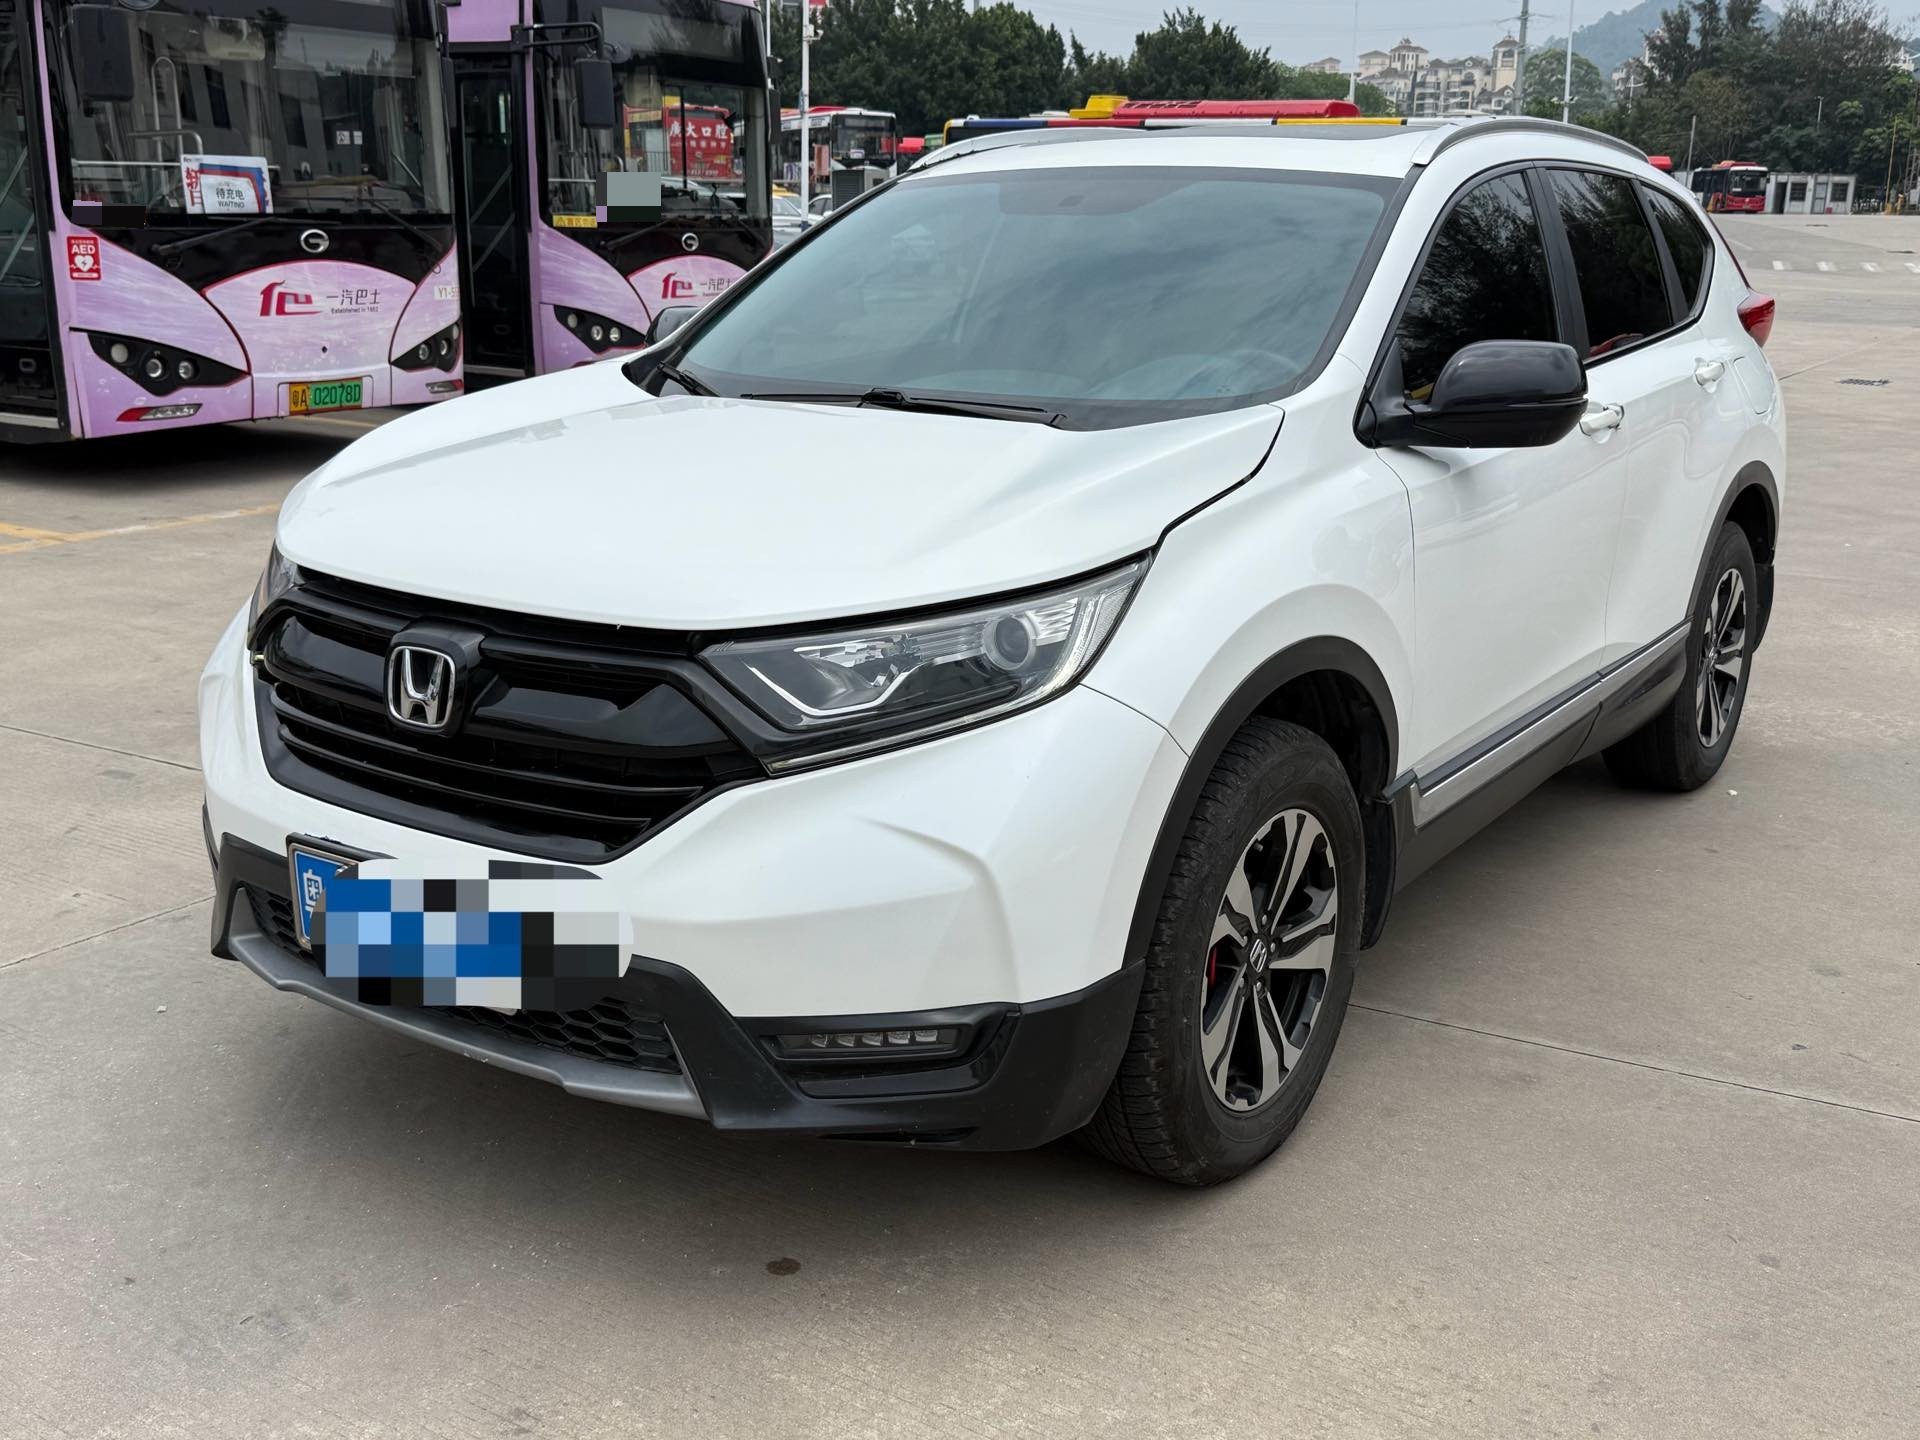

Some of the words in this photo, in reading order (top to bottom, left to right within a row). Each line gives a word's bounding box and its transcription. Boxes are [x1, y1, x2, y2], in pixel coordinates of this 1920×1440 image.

[215, 187, 245, 200] 待充电
[218, 200, 245, 208] WAITING
[71, 244, 96, 254] AED
[326, 288, 381, 305] 一汽巴士
